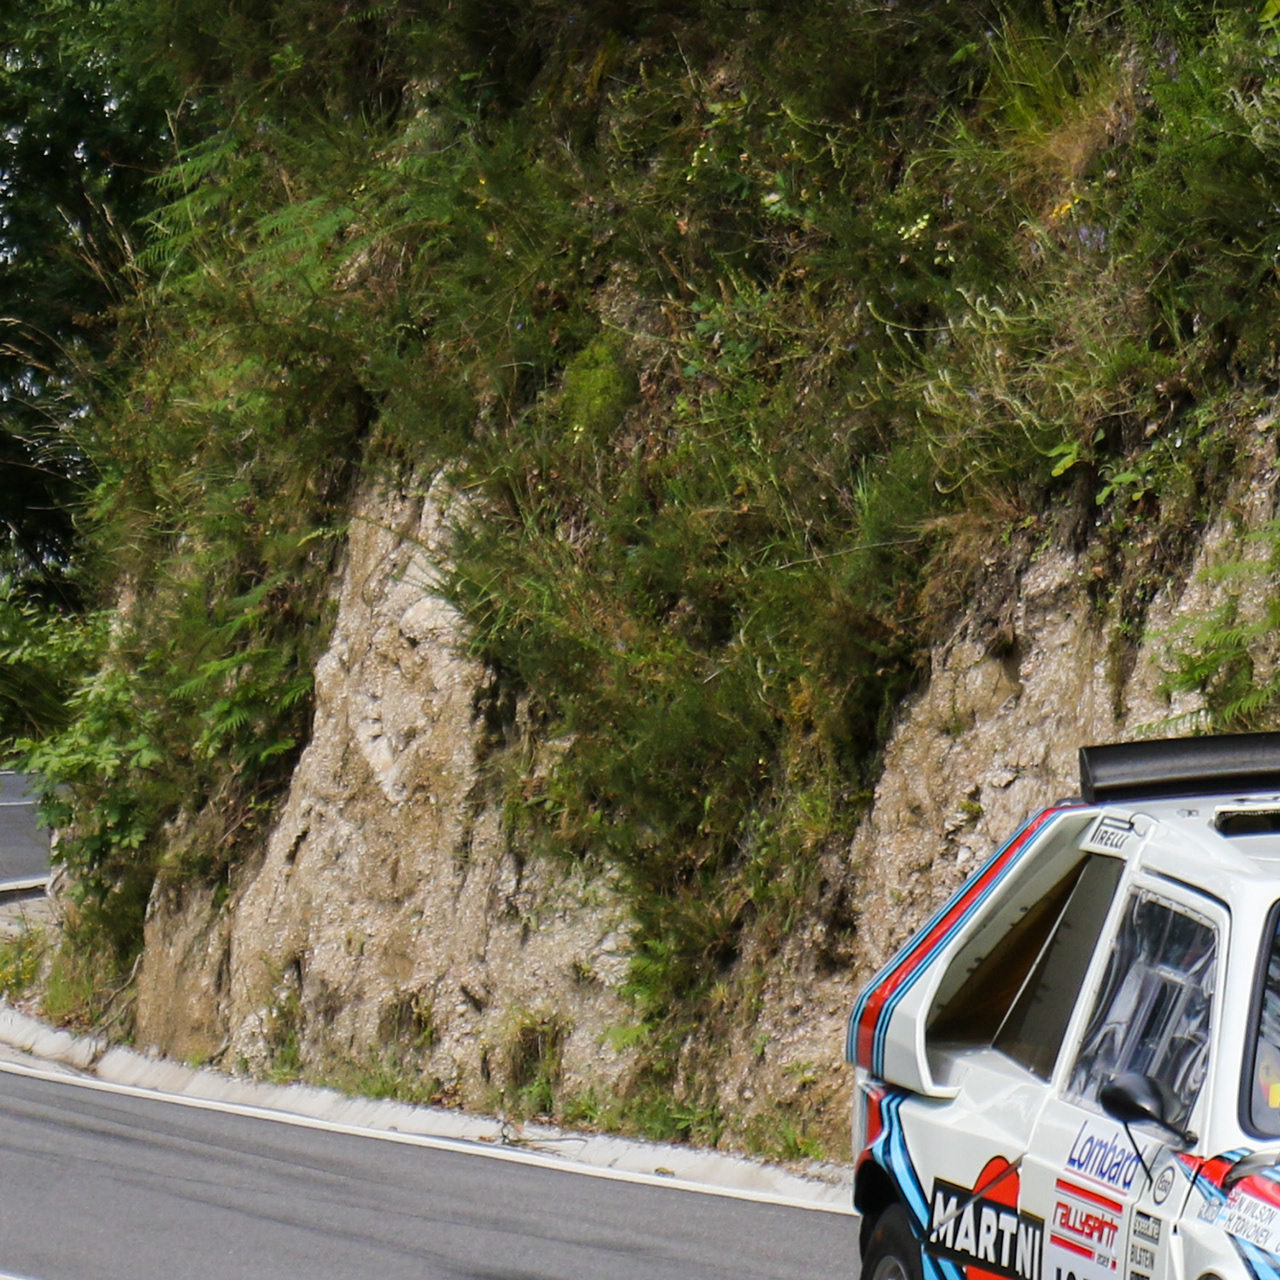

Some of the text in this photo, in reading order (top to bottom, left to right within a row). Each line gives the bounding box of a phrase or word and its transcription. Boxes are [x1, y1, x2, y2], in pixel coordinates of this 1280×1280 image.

[1090, 816, 1134, 850] PIRELLI
[1067, 1120, 1148, 1190] Lombard
[1244, 1199, 1278, 1226] WILSON
[1130, 1244, 1155, 1270] BILSTEIN
